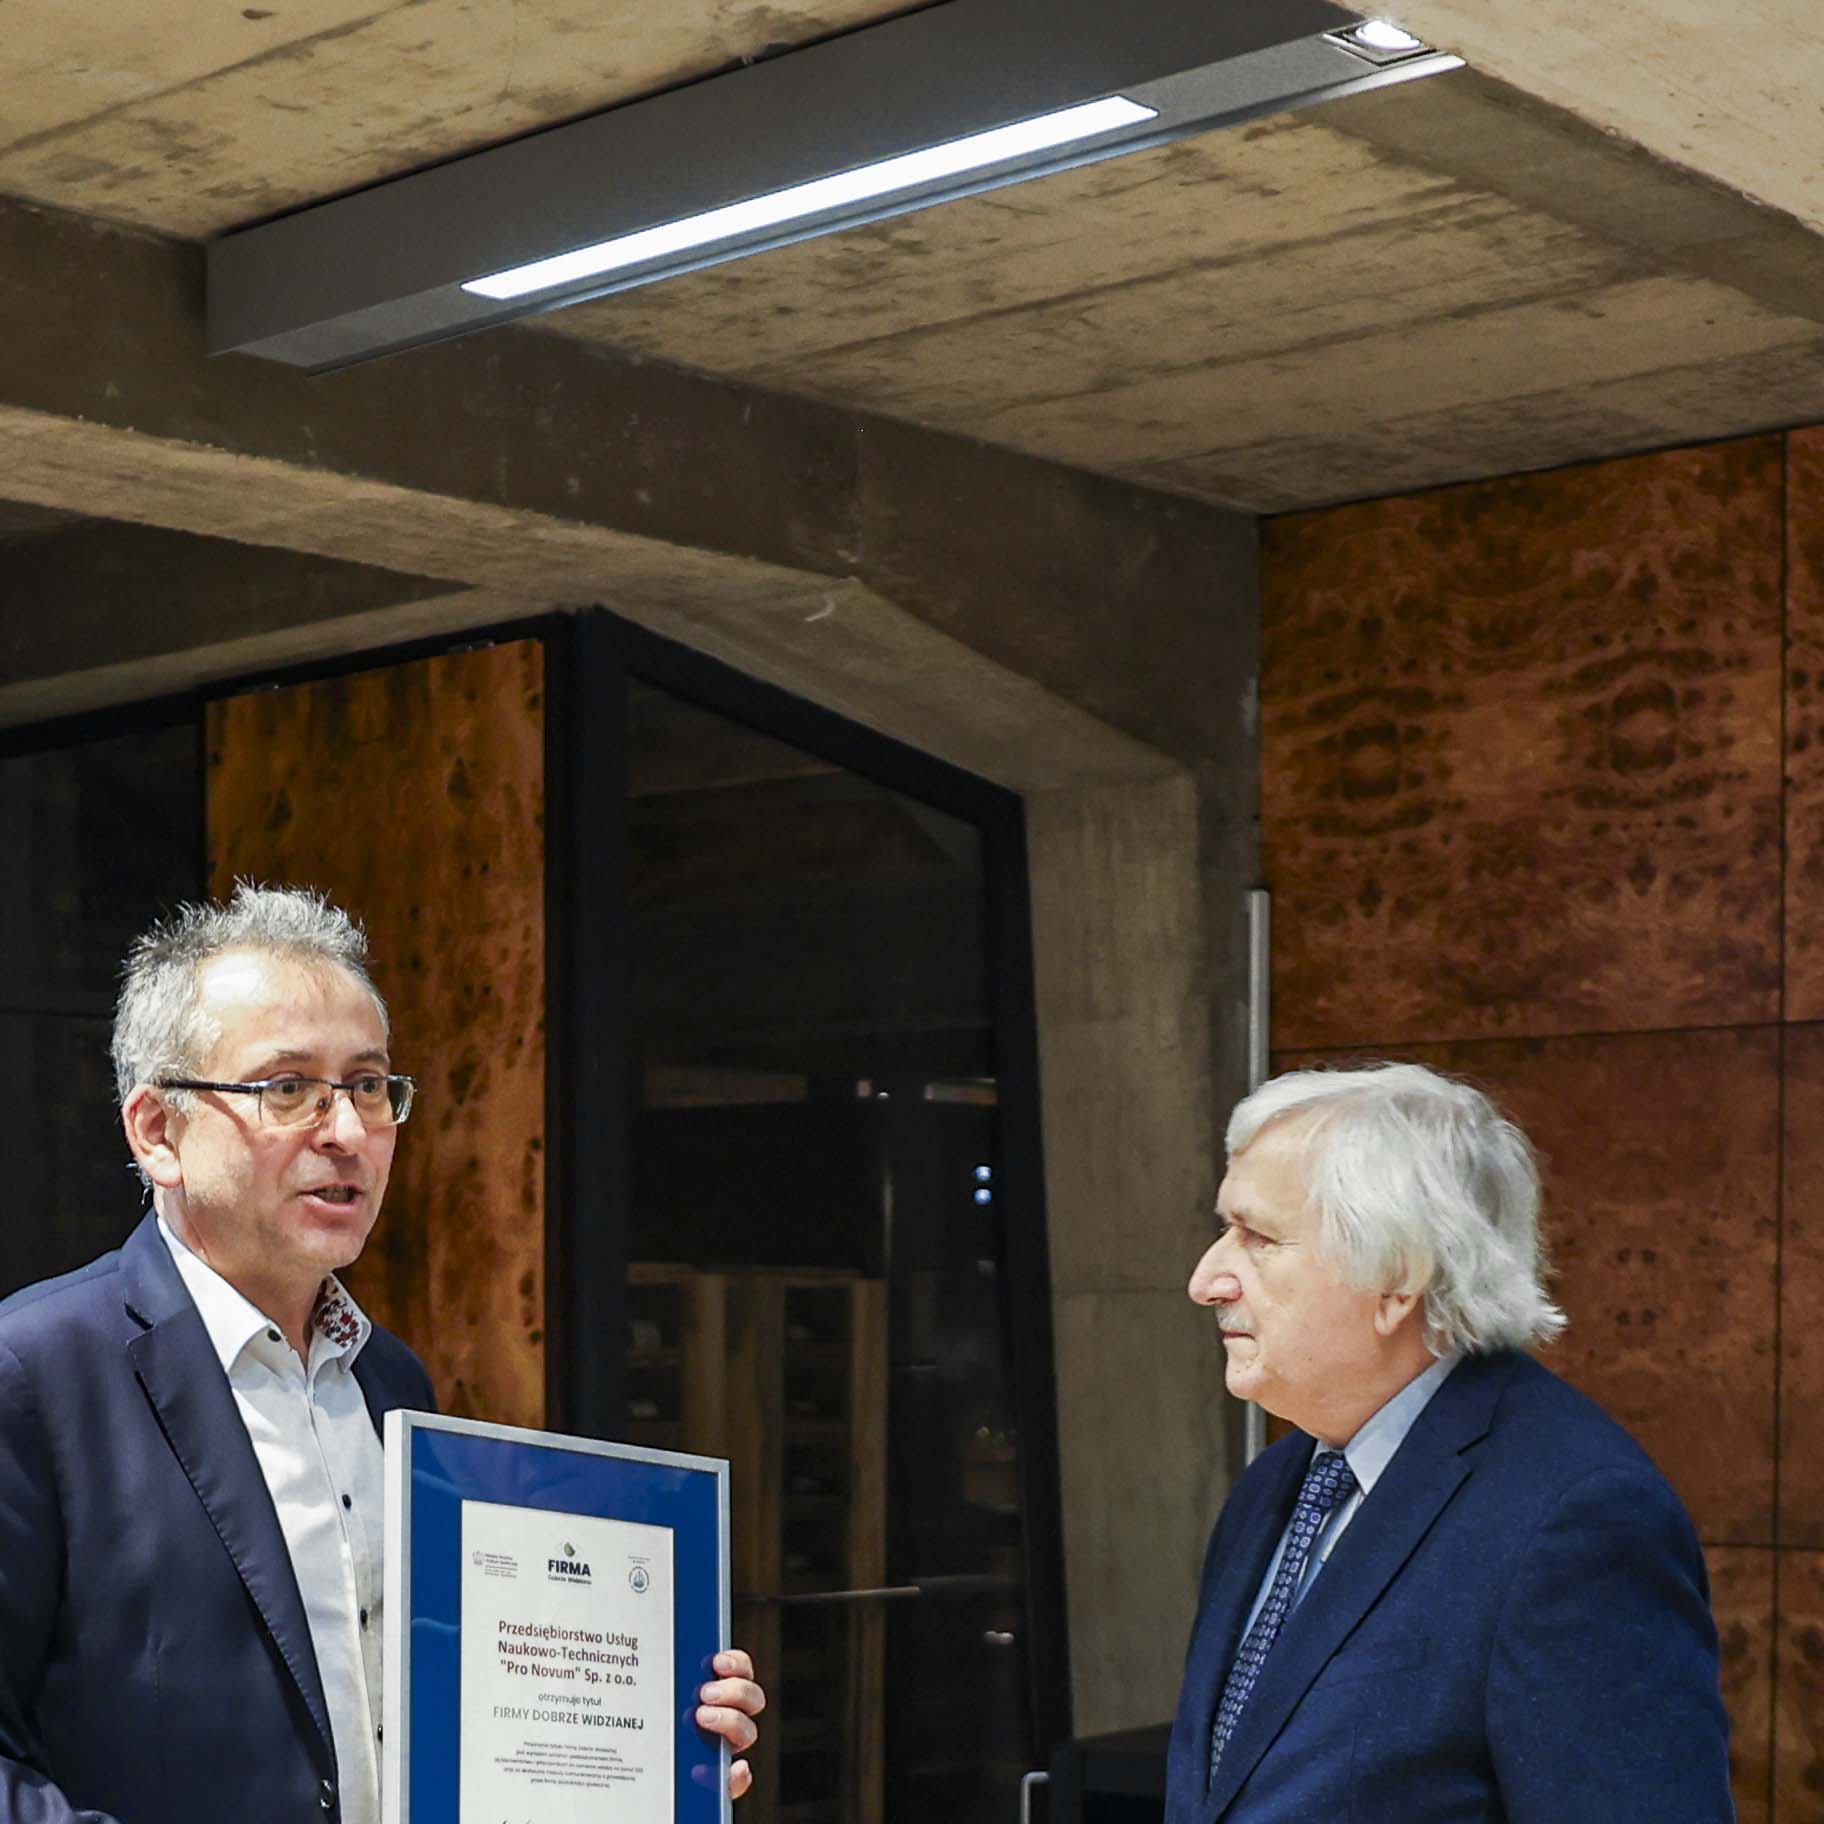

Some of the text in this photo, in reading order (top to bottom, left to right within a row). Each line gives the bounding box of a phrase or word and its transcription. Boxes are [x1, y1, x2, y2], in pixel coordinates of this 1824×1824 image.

[548, 1560, 591, 1577] FIRMA
[498, 1620, 639, 1650] Przedsiębiorstwo Usług
[498, 1640, 639, 1668] Naukowo-Technicznych
[500, 1659, 637, 1686] "Pro Novum" Sp. z o.o.
[538, 1693, 581, 1707] otrzymuje
[493, 1706, 644, 1730] FIRMY DOBRZE WIDZIANEJ
